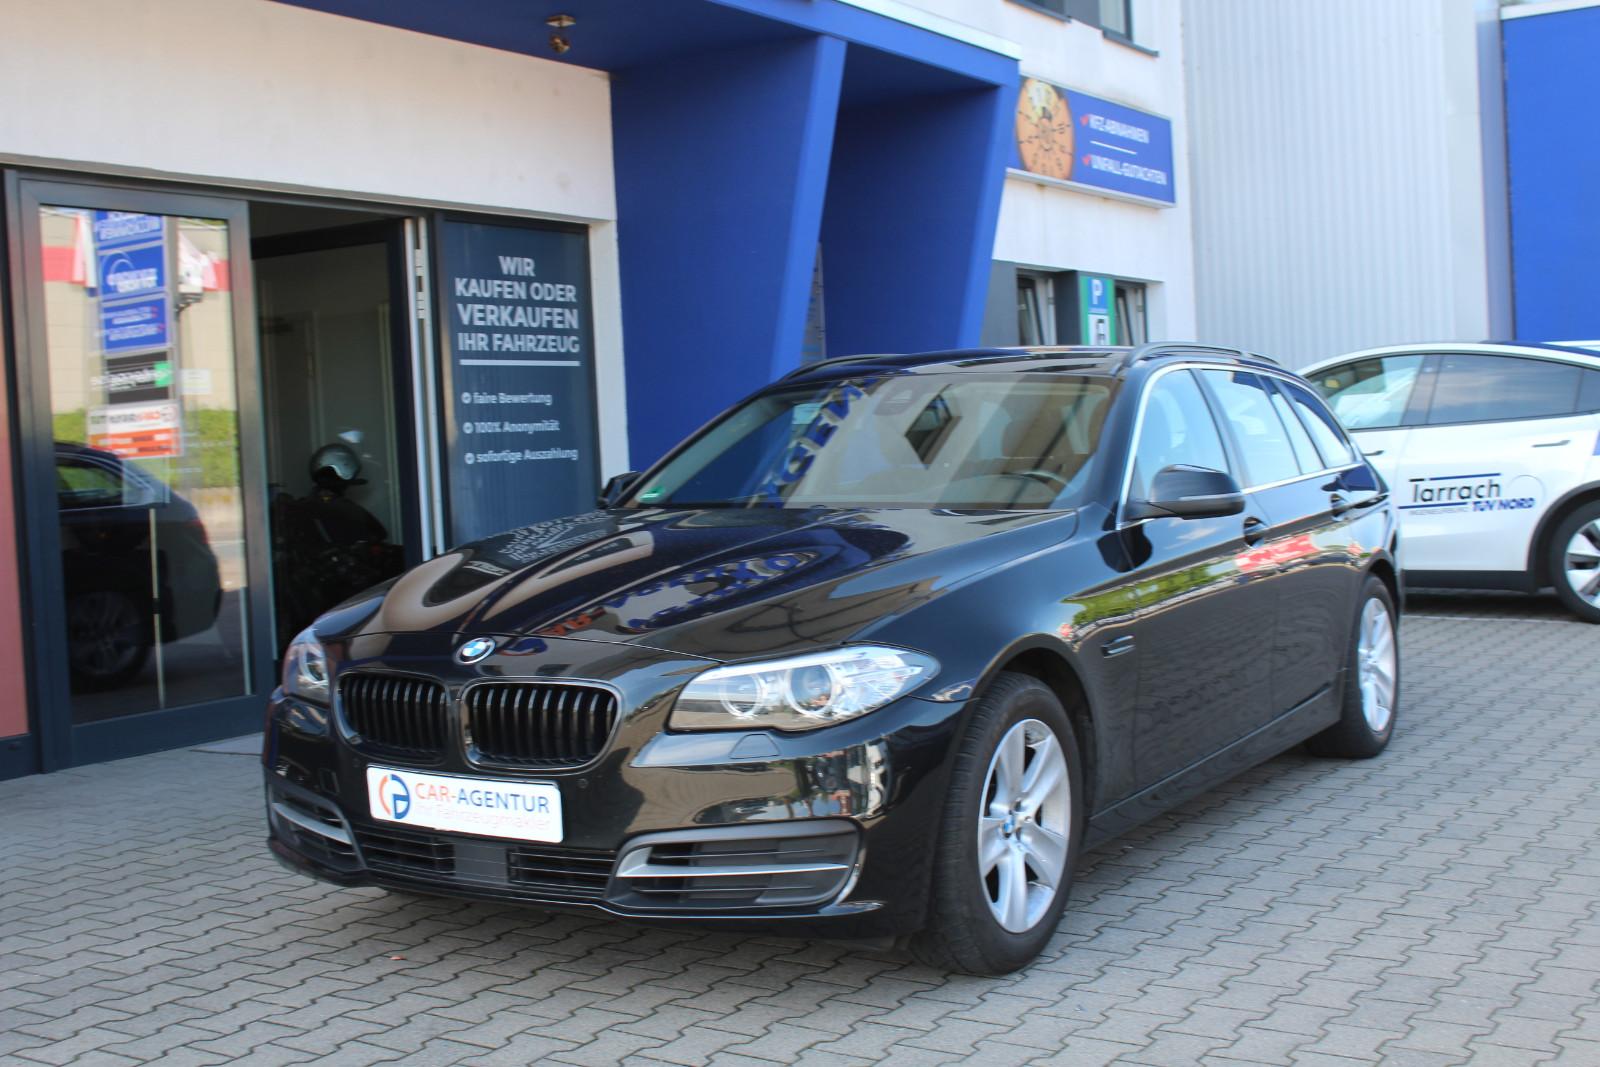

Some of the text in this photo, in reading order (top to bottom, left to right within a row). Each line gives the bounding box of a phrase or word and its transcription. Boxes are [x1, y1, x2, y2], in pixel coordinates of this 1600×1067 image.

[498, 255, 536, 277] WIR
[455, 277, 577, 302] KAUFEN ODER
[1091, 279, 1104, 305] P
[457, 303, 580, 329] VERKAUFEN
[457, 332, 581, 353] IHR FAHRZEUG
[472, 392, 552, 406] faire Bewertung
[475, 420, 560, 435] 100% Anonymität
[476, 448, 579, 464] sofortige Auszahlung
[1409, 478, 1502, 503] Tarrach
[1472, 500, 1496, 512] TÜV
[1498, 497, 1536, 510] NORD
[414, 782, 551, 814] CAR-AGENTUR
